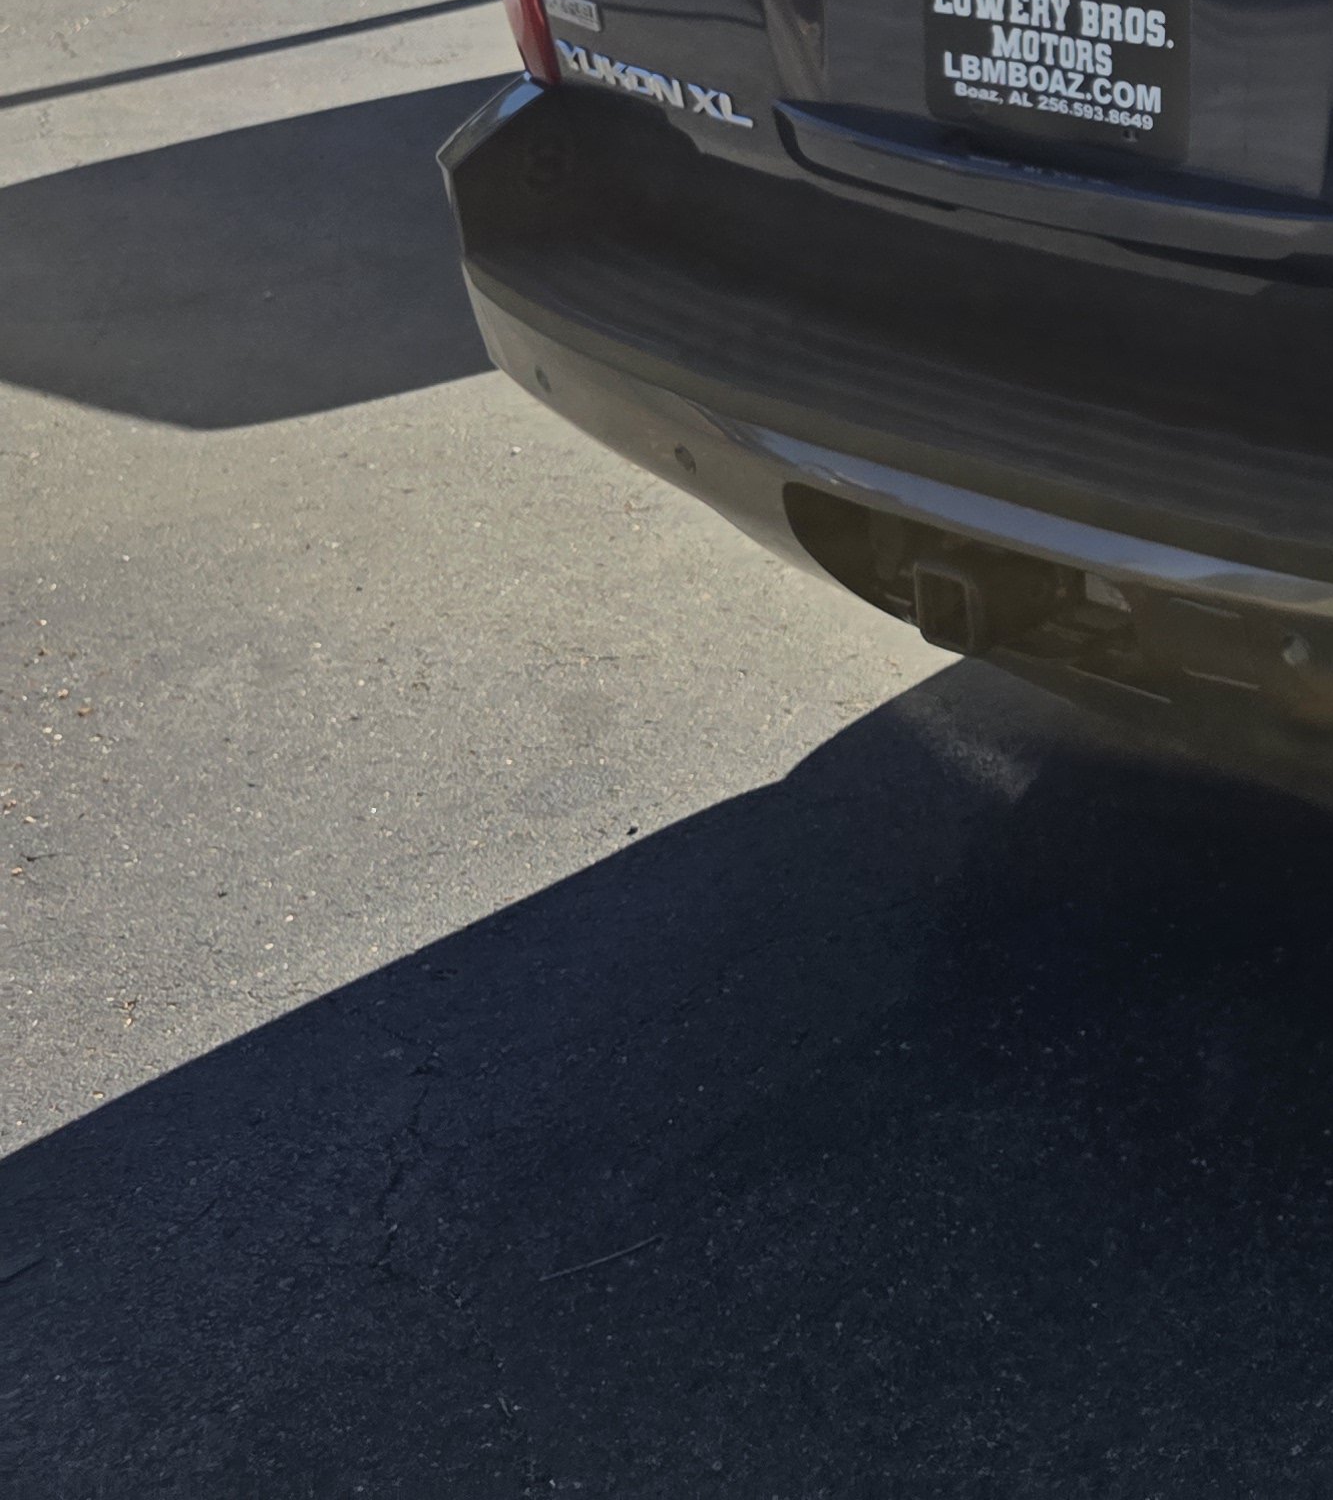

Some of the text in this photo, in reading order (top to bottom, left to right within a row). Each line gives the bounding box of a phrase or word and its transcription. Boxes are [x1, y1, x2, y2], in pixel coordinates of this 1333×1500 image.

[1080, 0, 1175, 49] BROS.
[991, 25, 1113, 76] MOTORS
[555, 38, 754, 128] YUKON XL
[943, 51, 1162, 113] LBMBOAZ.COM
[954, 81, 1154, 131] Boaz, AL 256.593.8649
